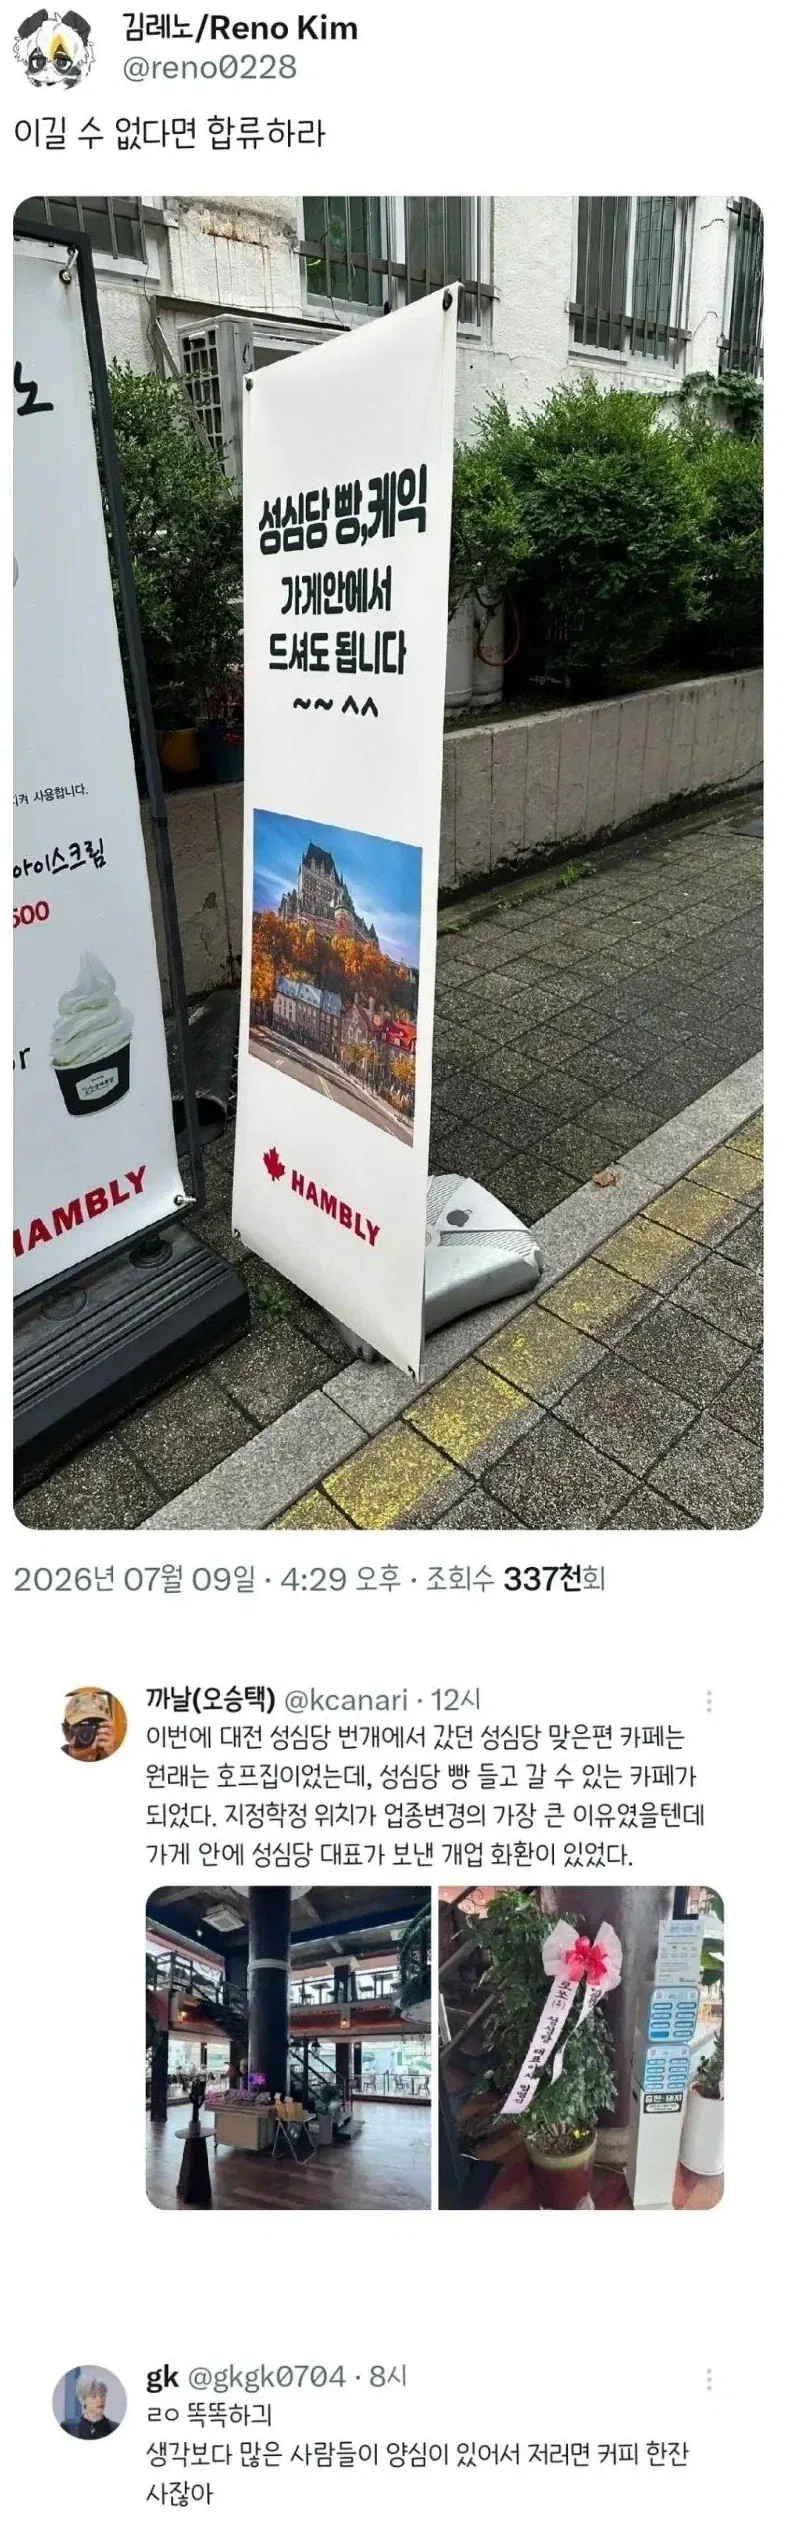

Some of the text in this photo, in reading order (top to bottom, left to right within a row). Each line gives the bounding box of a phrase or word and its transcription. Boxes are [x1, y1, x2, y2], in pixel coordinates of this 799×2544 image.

[258, 463, 428, 556] 성심당 빵,케익
[280, 564, 393, 616] 가게안에서
[268, 629, 408, 675] 드셔도 됩니다
[33, 782, 89, 803] 사용합니다.
[13, 838, 107, 879] 아이스크림
[291, 1168, 381, 1248] HAMBLY
